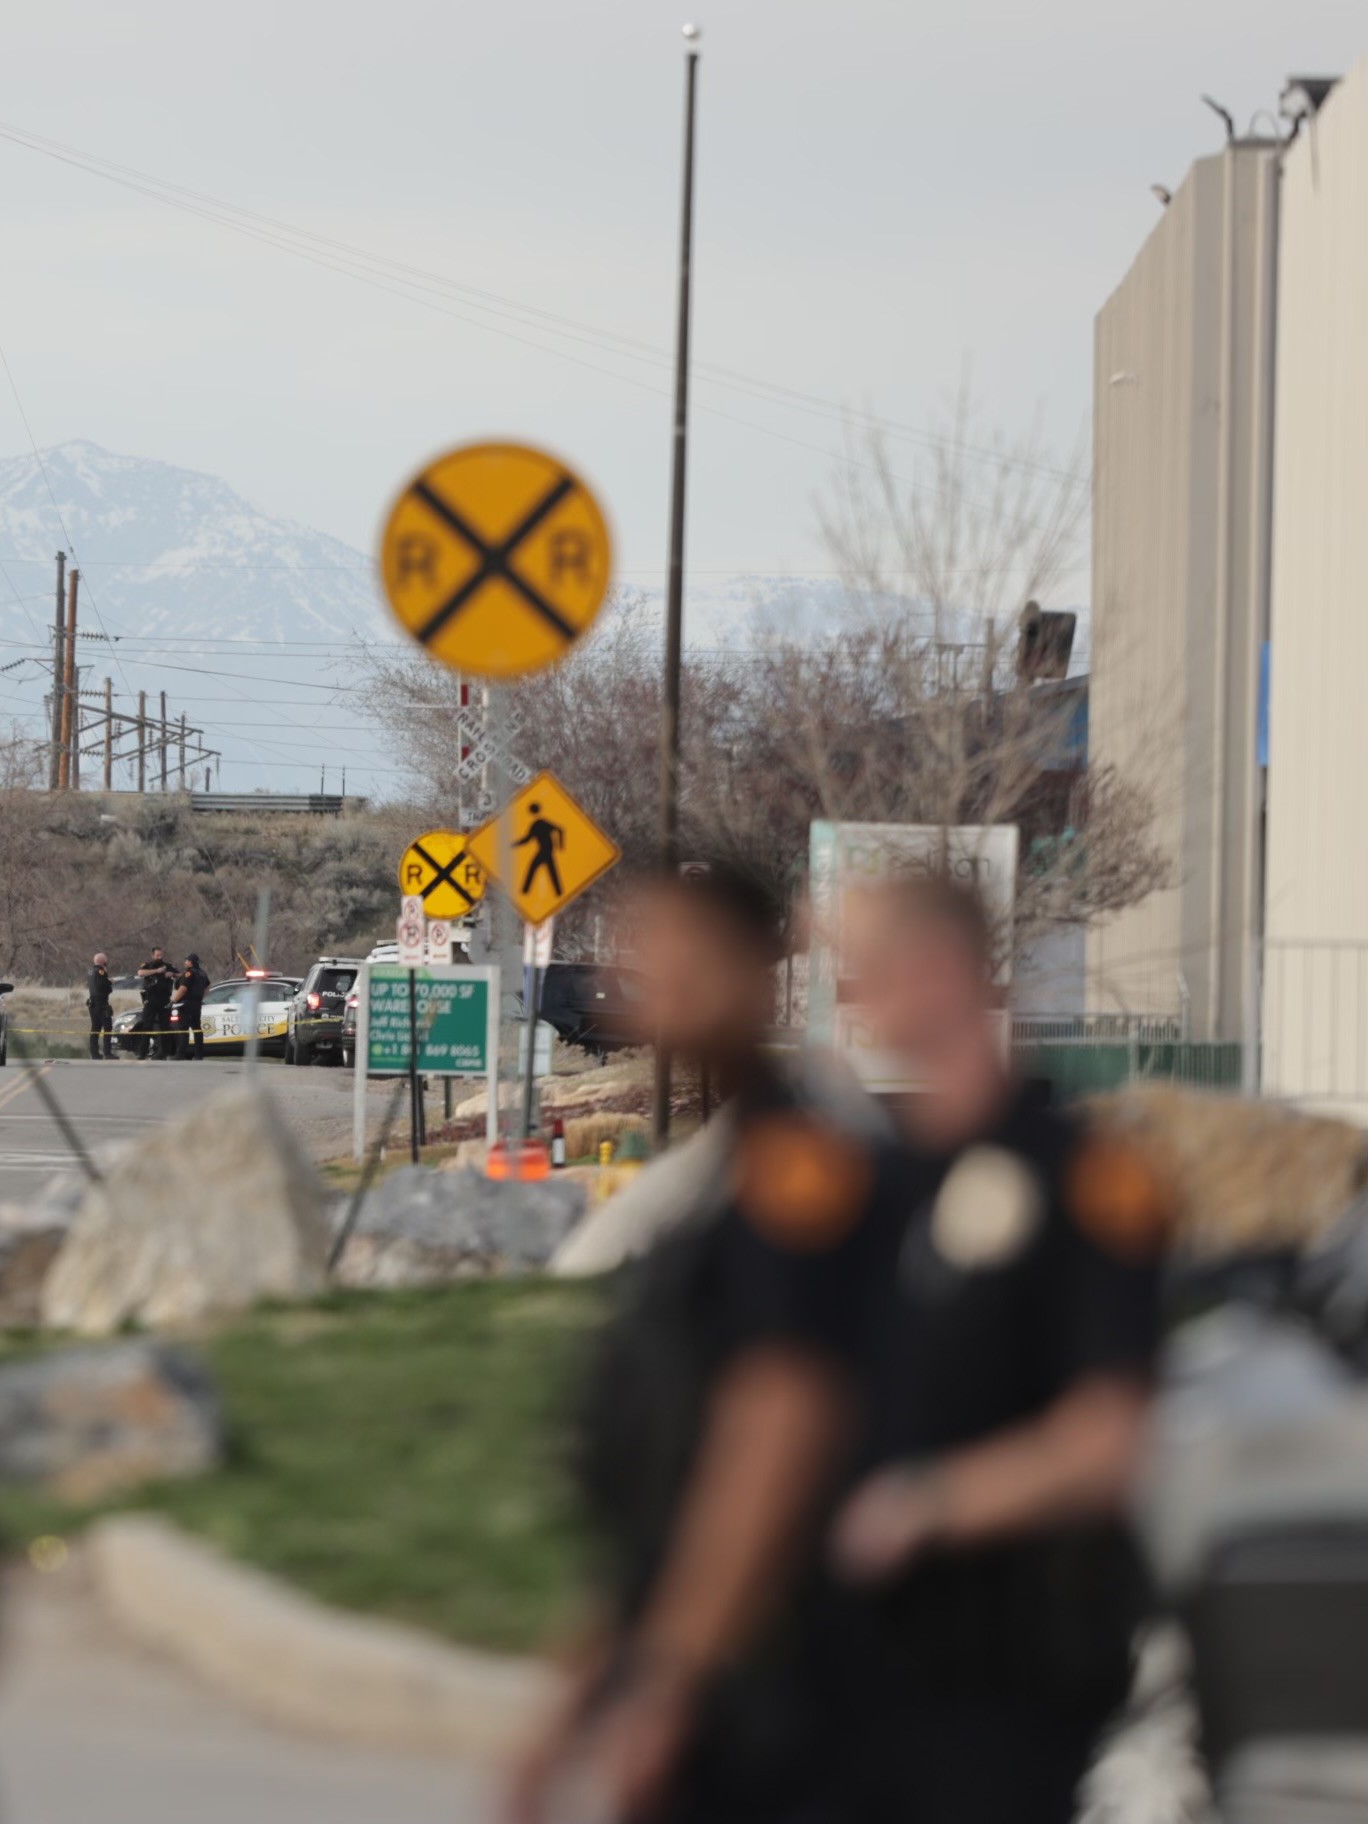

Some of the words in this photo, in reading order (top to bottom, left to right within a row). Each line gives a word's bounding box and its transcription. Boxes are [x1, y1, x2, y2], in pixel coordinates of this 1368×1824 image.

[396, 530, 438, 592] R
[549, 526, 591, 587] R
[407, 865, 423, 885] R
[465, 864, 481, 884] R
[223, 1024, 275, 1036] POCE
